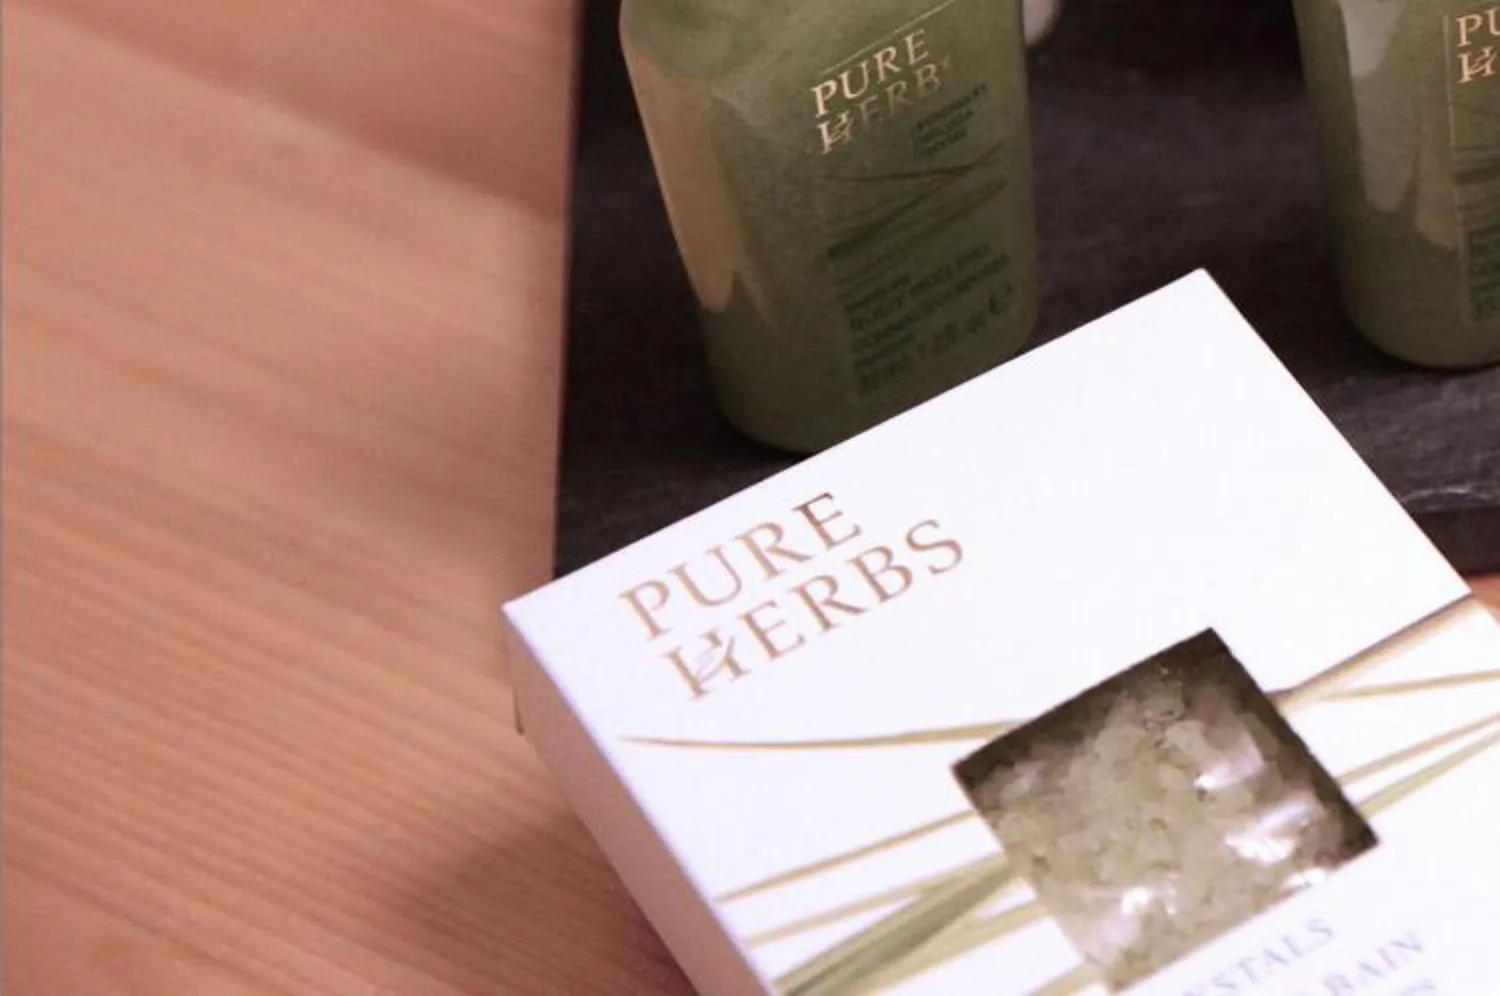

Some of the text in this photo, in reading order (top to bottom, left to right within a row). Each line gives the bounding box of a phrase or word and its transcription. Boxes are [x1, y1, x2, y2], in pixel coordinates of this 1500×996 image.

[811, 29, 930, 120] PURE
[617, 491, 862, 642] PURE
[661, 518, 965, 702] HERBS
[1181, 918, 1333, 996] STALS
[1322, 929, 1424, 996] BAIN
